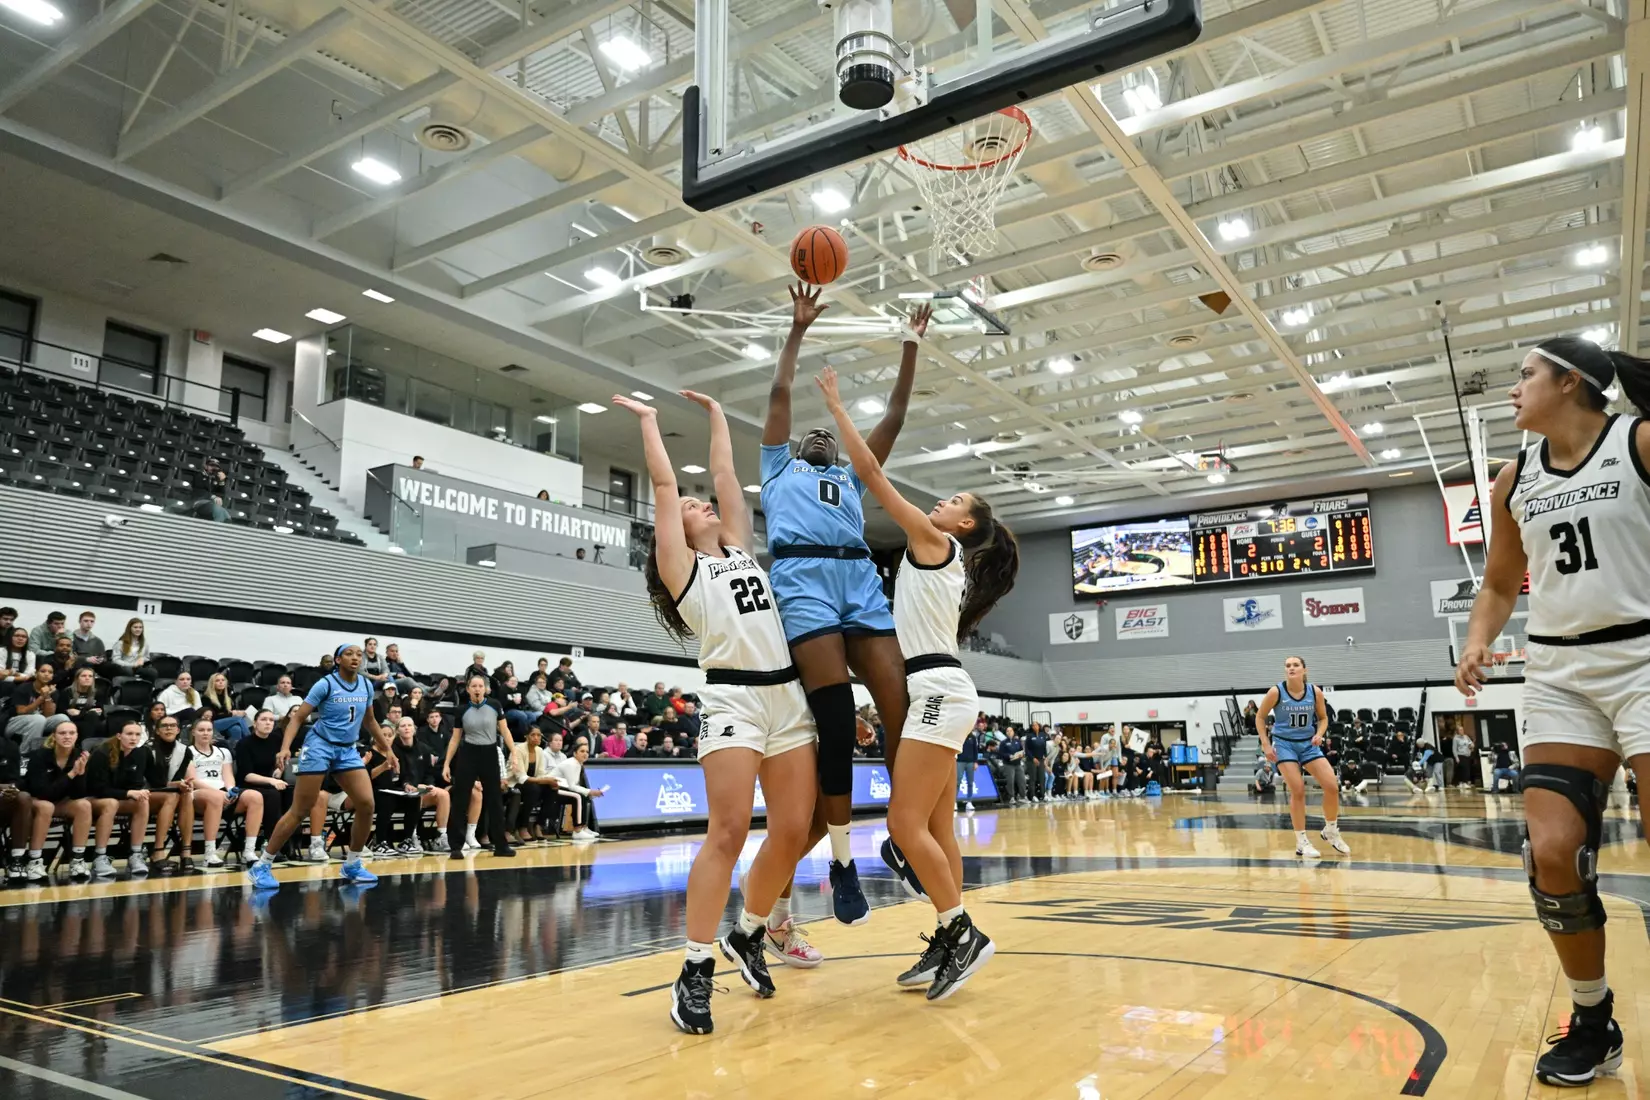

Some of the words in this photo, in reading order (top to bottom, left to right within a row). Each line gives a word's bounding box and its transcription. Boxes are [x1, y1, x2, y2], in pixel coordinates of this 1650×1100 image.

[74, 356, 89, 368] 111
[818, 479, 841, 507] 0
[1314, 499, 1348, 512] FRIARS
[1524, 482, 1620, 522] PROVIDENCE
[399, 476, 498, 520] WELCOME
[504, 502, 526, 526] TO
[531, 508, 626, 548] FRIARTOWN
[1197, 510, 1247, 527] PROVIDENCE
[1267, 518, 1296, 533] 7:36
[1278, 543, 1282, 552] 1
[1314, 536, 1323, 550] 2
[1549, 516, 1598, 575] 31
[1248, 544, 1256, 558] 2
[1320, 556, 1328, 566] 2
[1241, 564, 1248, 574] 0
[730, 576, 771, 615] 22
[144, 604, 155, 614] 11
[1126, 608, 1158, 618] BIG
[1122, 617, 1166, 628] EAST
[349, 705, 356, 723] 1
[1289, 712, 1308, 728] 10
